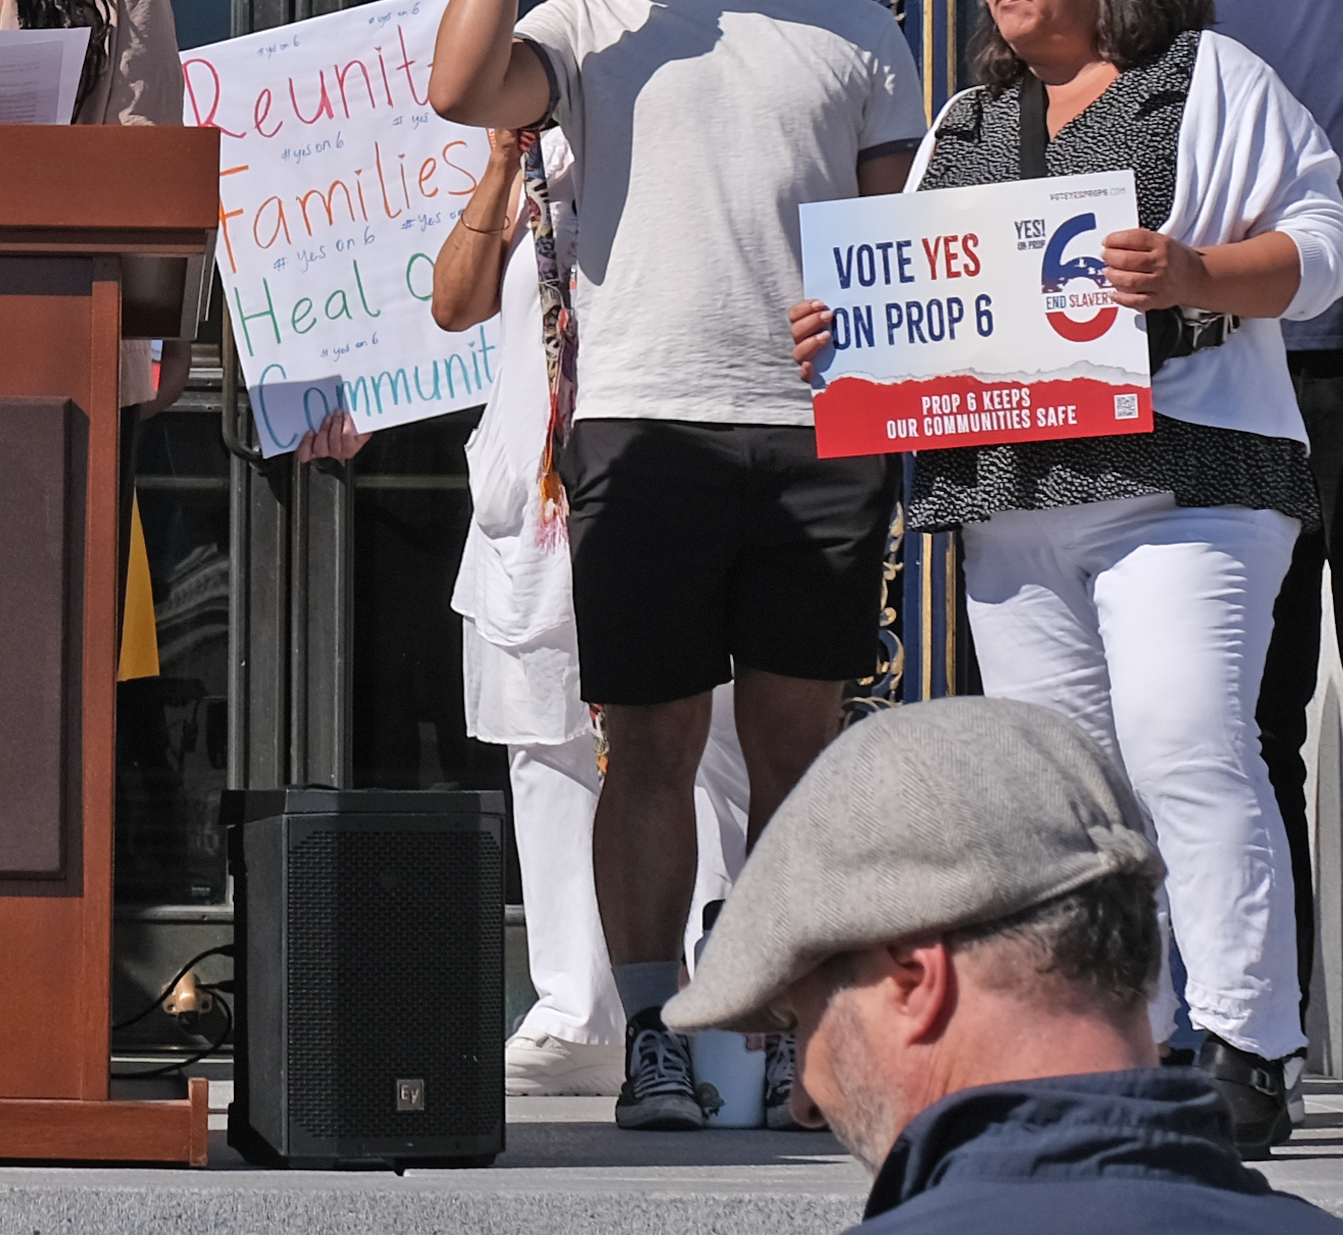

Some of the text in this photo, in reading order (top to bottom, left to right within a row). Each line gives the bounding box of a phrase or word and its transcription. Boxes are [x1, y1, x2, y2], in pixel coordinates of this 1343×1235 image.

[293, 35, 300, 47] 6
[182, 24, 433, 139] Reunit
[315, 140, 332, 153] on
[335, 131, 344, 148] 6
[335, 238, 356, 253] on
[364, 226, 375, 246] 6
[1014, 219, 1046, 240] YES!
[833, 233, 981, 290] VOTE YES
[234, 259, 381, 356] Heal
[1046, 296, 1067, 310] END
[833, 294, 994, 350] ON PROP 6
[372, 331, 379, 345] 6
[259, 325, 496, 449] Communit
[921, 388, 1031, 415] PROP 6 KEEPS
[886, 405, 1078, 440] OUR COMMUNITIES SAFE
